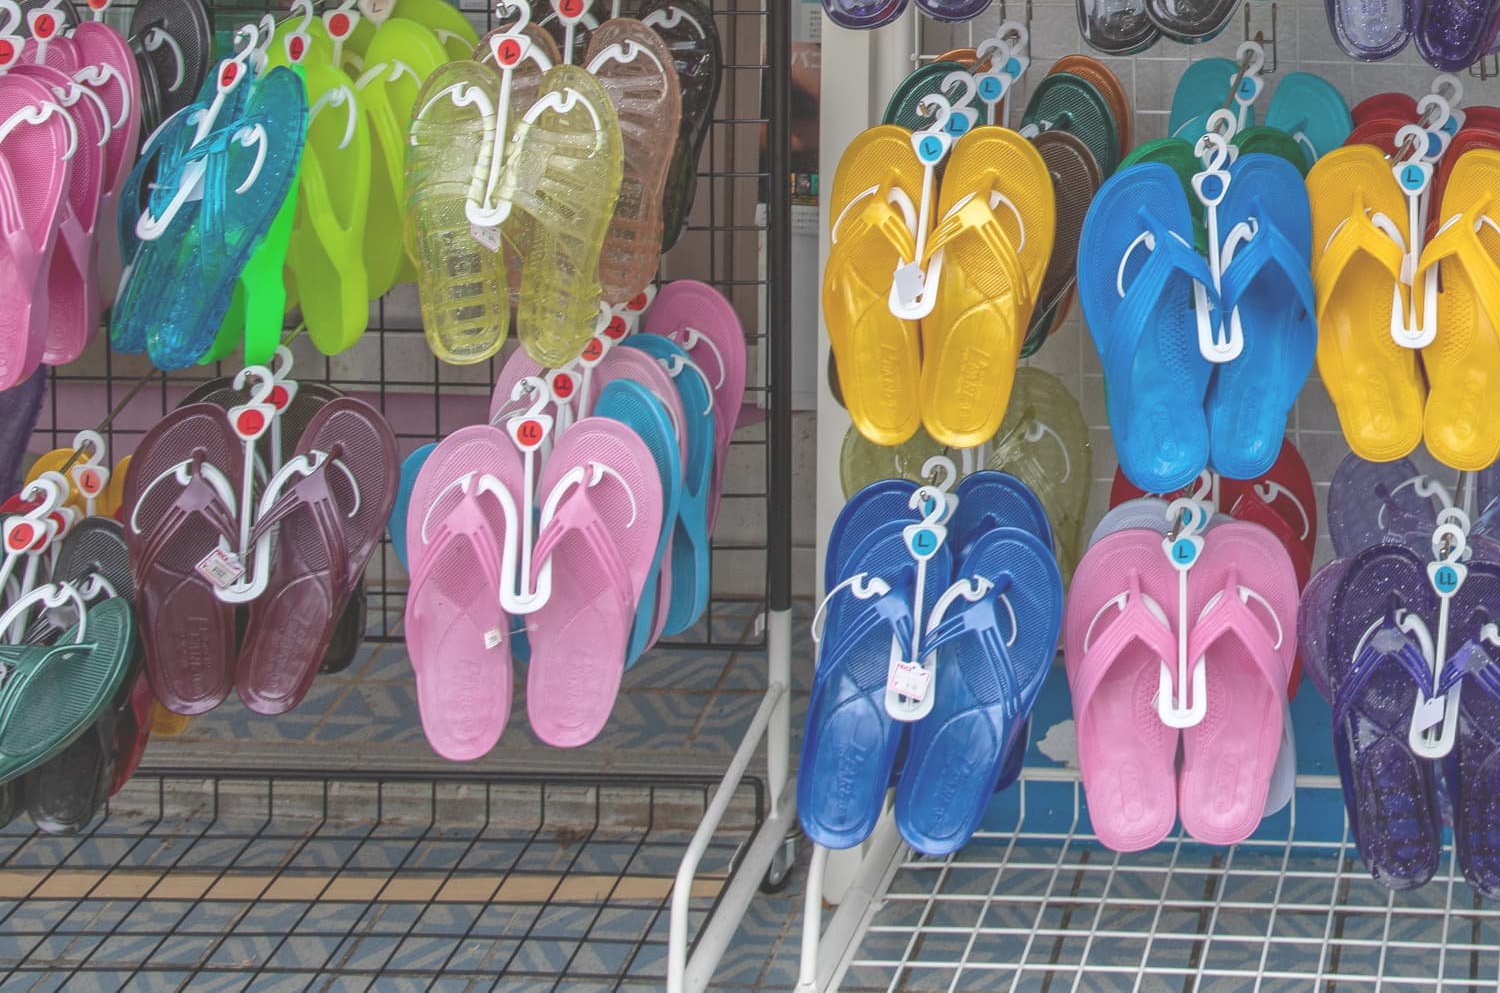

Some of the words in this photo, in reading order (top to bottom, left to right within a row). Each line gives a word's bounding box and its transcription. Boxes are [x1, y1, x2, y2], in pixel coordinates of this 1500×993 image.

[371, 2, 383, 14] L
[40, 18, 48, 32] L
[504, 44, 516, 60] L
[984, 80, 993, 93] L
[1239, 80, 1251, 93] L
[950, 118, 963, 132] L
[924, 142, 938, 156] L
[1406, 169, 1419, 183] L
[522, 427, 538, 439] LL
[85, 473, 94, 488] L
[14, 529, 25, 543] L
[917, 534, 929, 548] L
[1177, 545, 1188, 559] L
[1438, 571, 1457, 586] LL
